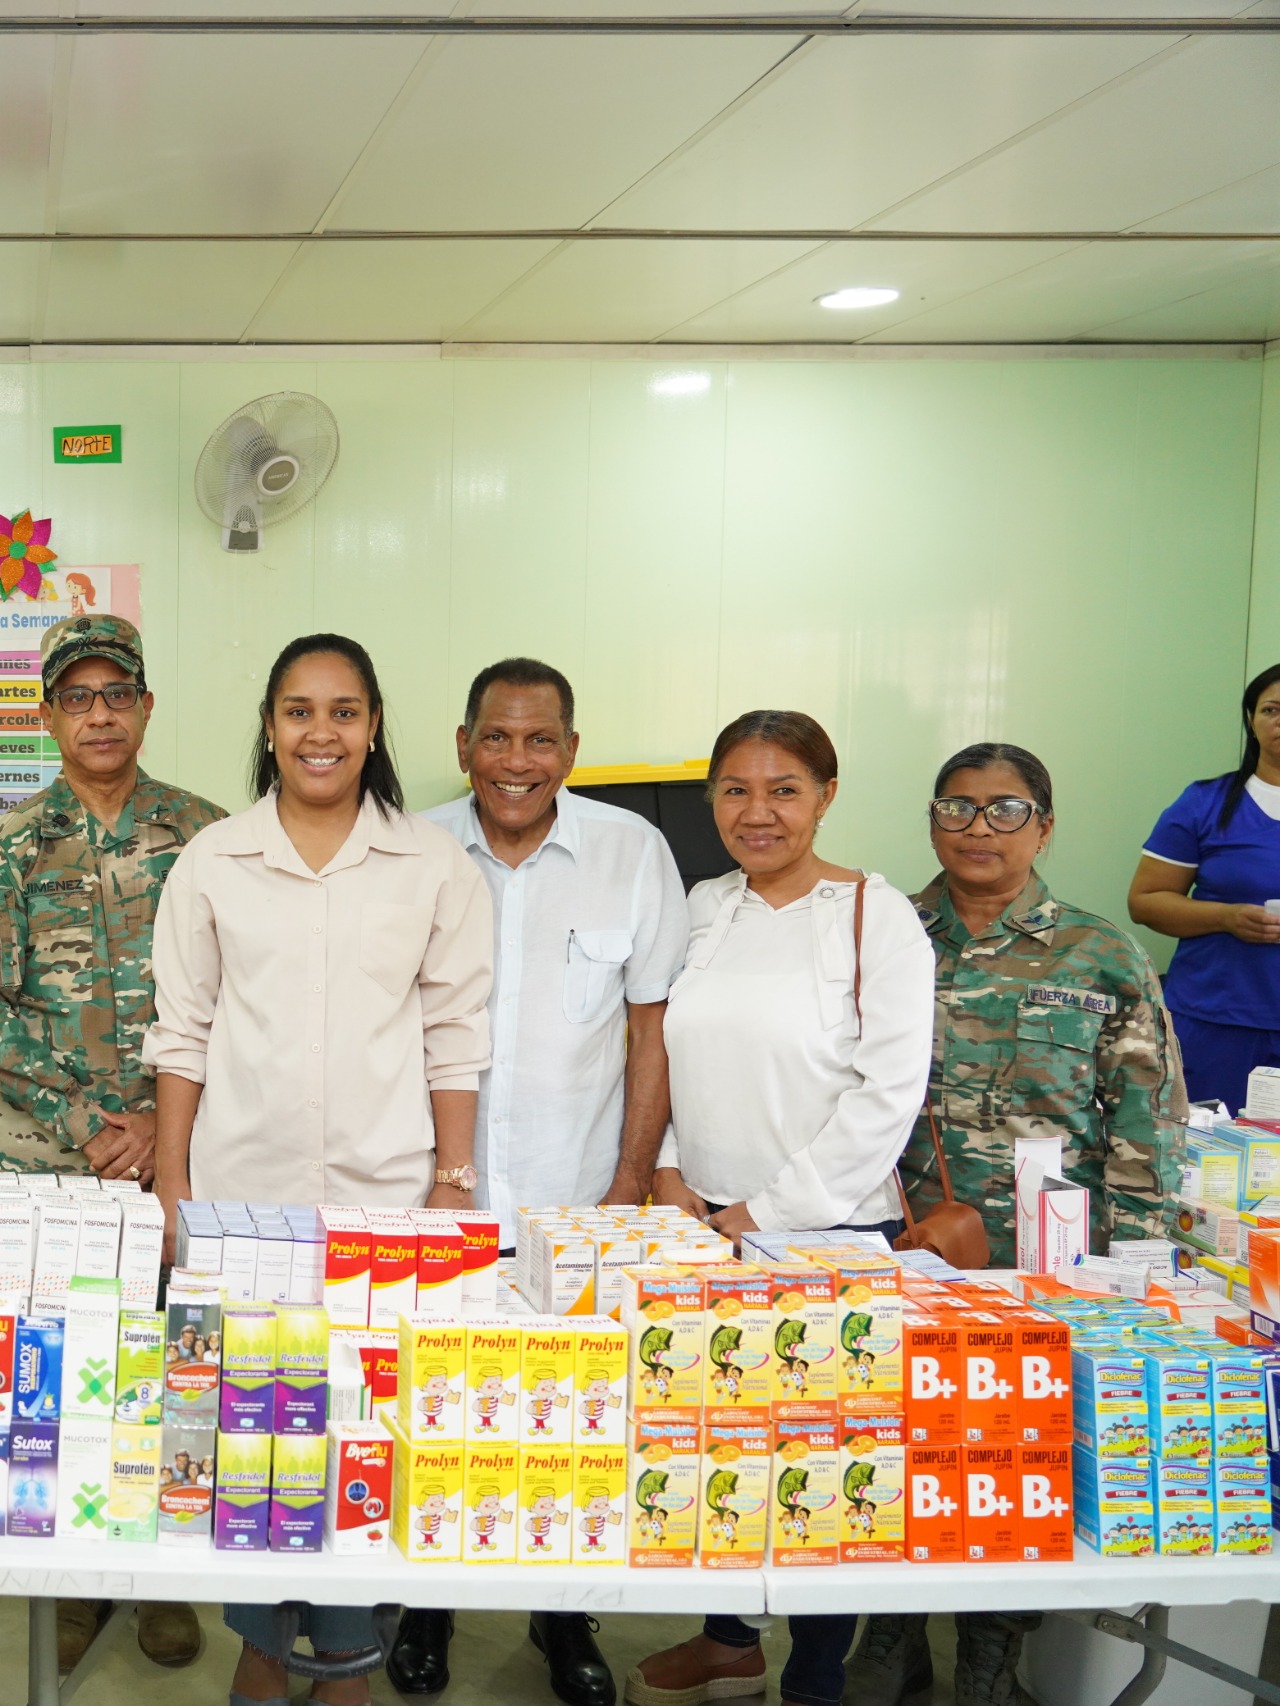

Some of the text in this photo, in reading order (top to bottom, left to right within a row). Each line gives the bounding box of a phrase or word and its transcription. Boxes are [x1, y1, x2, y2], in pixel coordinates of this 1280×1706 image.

[62, 436, 111, 455] NORTE
[24, 880, 85, 896] JIMENEZ
[1033, 990, 1077, 1004] FUERZA
[84, 1220, 118, 1228] FOSFOMICINA
[329, 1242, 369, 1258] Prolyn
[375, 1246, 415, 1262] Prolyn
[421, 1246, 462, 1262] Prolyn
[871, 1278, 897, 1289] kids
[743, 1292, 769, 1303] kids
[805, 1285, 831, 1297] kids
[675, 1294, 700, 1306] kids
[70, 1308, 113, 1319] MUCOTOX
[417, 1334, 462, 1350] Prolyn
[472, 1335, 517, 1350] Prolyn
[526, 1337, 571, 1352] Prolyn
[912, 1333, 957, 1346] COMPLEJO
[968, 1333, 1013, 1346] COMPLEJO
[1022, 1331, 1067, 1345] COMPLEJO
[579, 1338, 624, 1353] Prolyn
[227, 1353, 272, 1364] Resfridol
[280, 1353, 325, 1365] Resfridol
[18, 1342, 32, 1394] SUMOX
[168, 1372, 216, 1382] Broncochem
[911, 1356, 957, 1399] B+
[967, 1357, 1013, 1400] B+
[1022, 1356, 1069, 1398] B+
[1100, 1372, 1142, 1382] Diclofenac
[1166, 1374, 1206, 1384] Diclofenac
[1219, 1372, 1260, 1382] Diclofenac
[140, 1387, 149, 1400] 8
[64, 1435, 108, 1444] MUCOTOX
[810, 1433, 835, 1445] kids
[876, 1429, 901, 1440] kids
[12, 1435, 53, 1451] Sutox
[672, 1437, 696, 1449] kids
[743, 1438, 767, 1450] kids
[415, 1453, 459, 1469] Prolyn
[470, 1453, 514, 1469] Prolyn
[525, 1455, 570, 1470] Prolyn
[579, 1454, 624, 1469] Prolyn
[913, 1450, 957, 1464] COMPLEJO
[968, 1449, 1012, 1464] COMPLEJO
[1023, 1450, 1068, 1464] COMPLEJO
[222, 1471, 267, 1482] Resfridol
[1104, 1472, 1146, 1481] Diclofenac
[162, 1494, 209, 1505] Broncochem
[912, 1474, 958, 1517] B+
